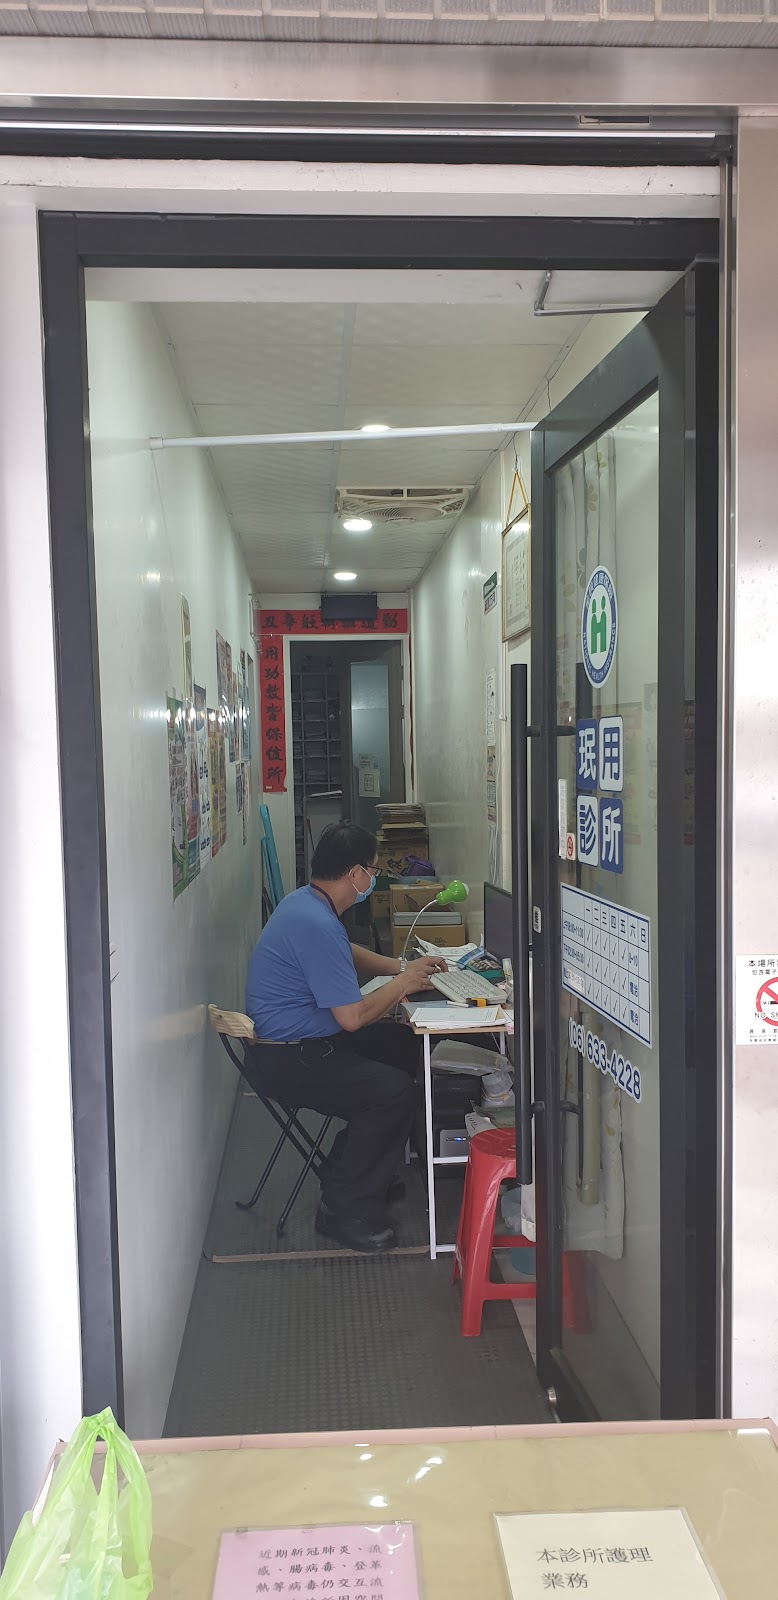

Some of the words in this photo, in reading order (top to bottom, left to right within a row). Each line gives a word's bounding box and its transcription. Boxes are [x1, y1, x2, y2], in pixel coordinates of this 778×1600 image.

[579, 804, 622, 865] 診所
[594, 907, 599, 921] 二
[602, 911, 607, 926] 三
[610, 914, 616, 929] 四
[620, 919, 626, 934] 五
[629, 923, 636, 939] 六
[640, 927, 646, 943] 日
[748, 959, 778, 968] 本場所
[568, 1018, 586, 1055] (06)
[587, 1032, 641, 1100] 633-4228
[258, 1543, 383, 1560] 近期新冠肺炎、流
[535, 1546, 653, 1564] 本診所護理
[256, 1560, 383, 1577] 感、腸病毒、登革
[255, 1577, 385, 1594] 熱等病毒仍交互流
[541, 1572, 589, 1590] 業務
